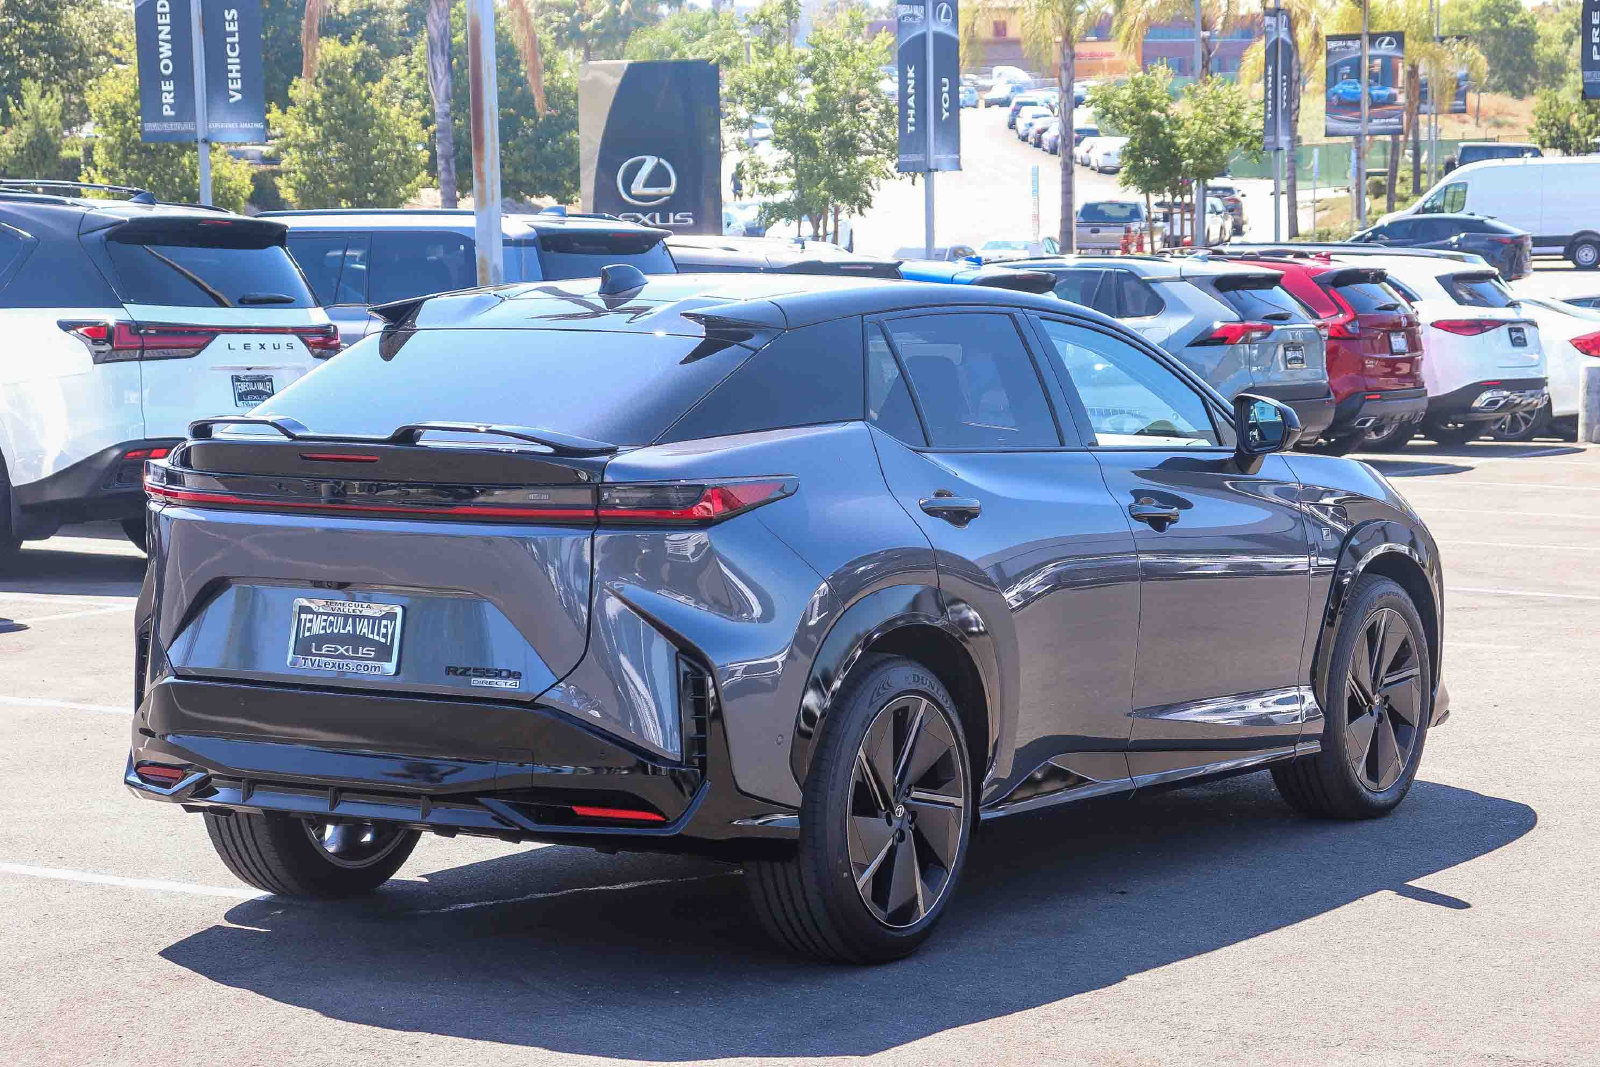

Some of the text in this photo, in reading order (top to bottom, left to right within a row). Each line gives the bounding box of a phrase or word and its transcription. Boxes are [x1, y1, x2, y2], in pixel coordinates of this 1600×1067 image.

[1591, 11, 1600, 60] PRE
[156, 0, 175, 116] PRE OWNED
[224, 8, 242, 103] VEHICLES
[907, 64, 916, 133] THANK
[941, 77, 950, 120] YOU
[618, 212, 694, 226] EXUS
[325, 601, 371, 610] TEMECULA
[300, 613, 395, 645] TEMECULA VALLEY
[302, 657, 381, 673] TVLexus.com
[311, 642, 376, 658] LEXUS
[472, 679, 518, 688] DIRECT4
